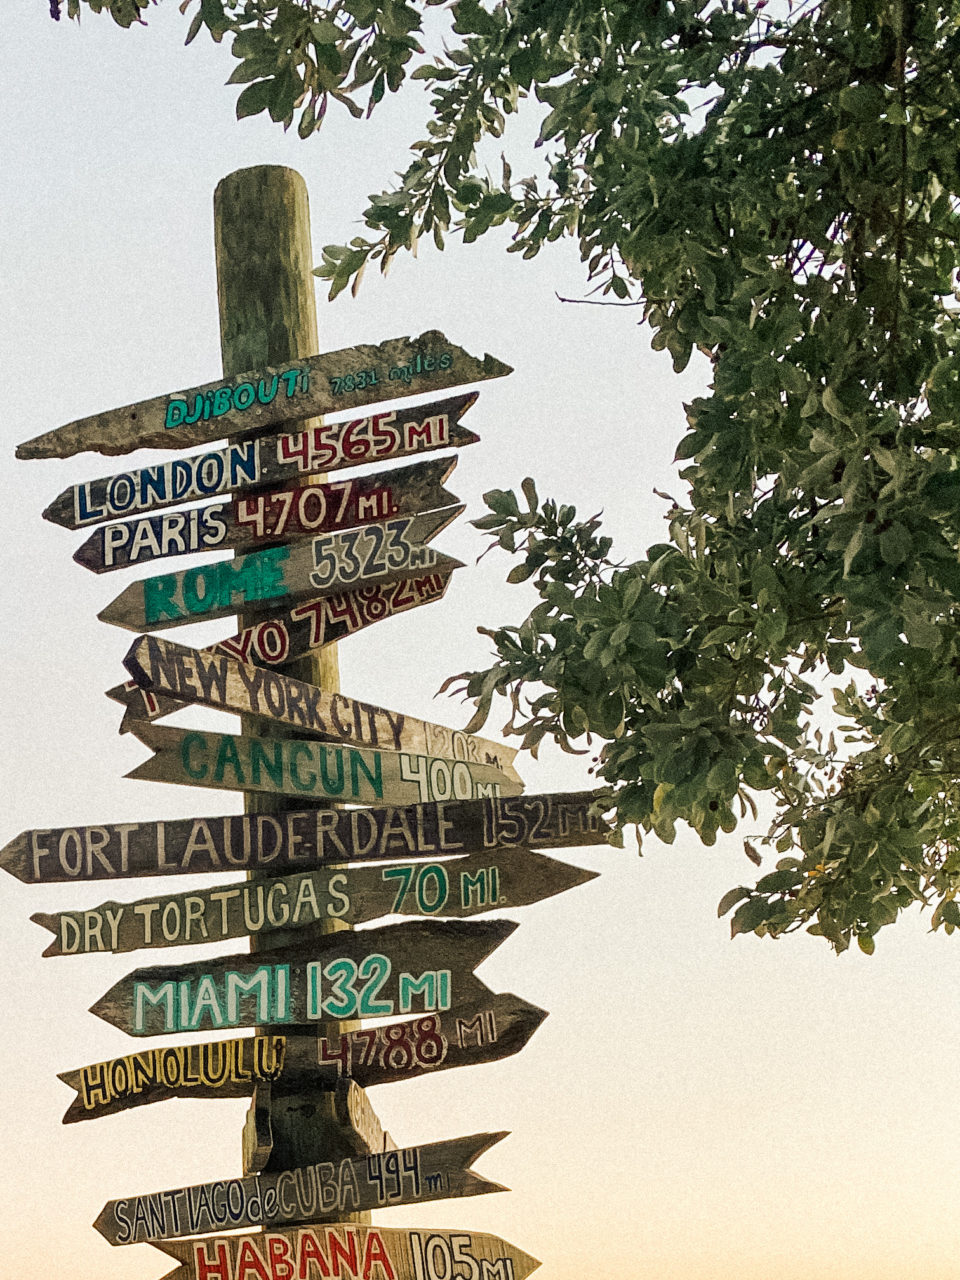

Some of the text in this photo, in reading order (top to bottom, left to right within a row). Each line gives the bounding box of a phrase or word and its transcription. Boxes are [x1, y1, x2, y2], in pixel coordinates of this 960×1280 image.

[329, 368, 379, 396] 7831
[388, 353, 454, 384] miles
[74, 411, 449, 525] LONDON 4565 MI
[237, 481, 353, 537] 4707
[143, 545, 290, 626] ROME
[147, 634, 228, 704] NEW
[238, 661, 328, 732] YORK
[330, 693, 405, 750] CITY
[180, 731, 384, 799] CANCUN
[398, 753, 474, 803] 400
[31, 824, 139, 880] FORT
[156, 801, 465, 869] LAUDERDALE
[483, 798, 554, 847] 152
[60, 908, 124, 954] DRY
[134, 873, 351, 944] TORTUGAS
[382, 864, 450, 914] 70
[133, 953, 452, 1033] MIAMI 132 MI
[79, 1010, 497, 1110] HONOLULU 4788 MI
[113, 1178, 246, 1245] SANTIAGO
[247, 1176, 279, 1222] de
[277, 1157, 361, 1218] CUBA
[367, 1147, 422, 1204] 494
